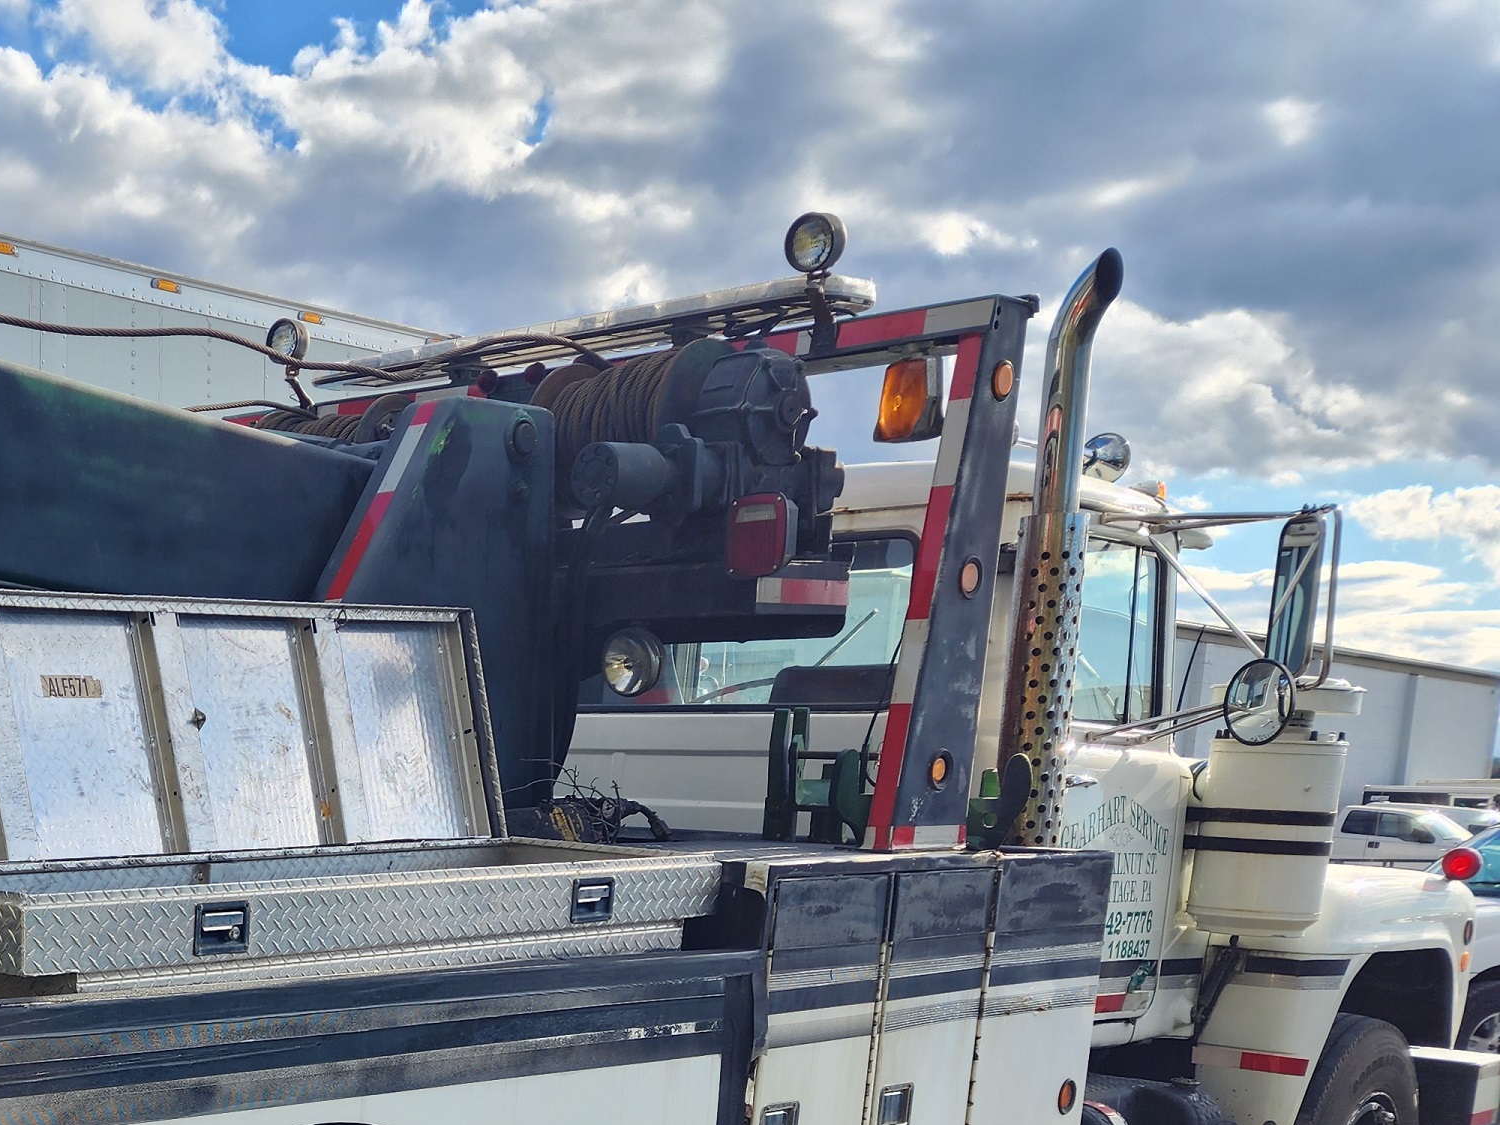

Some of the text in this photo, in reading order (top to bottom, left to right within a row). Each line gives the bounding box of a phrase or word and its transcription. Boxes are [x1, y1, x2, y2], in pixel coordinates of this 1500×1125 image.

[48, 677, 90, 697] ALF571
[1060, 796, 1169, 855] GEARHART SERVICE
[1145, 852, 1157, 874] ST.
[1108, 880, 1151, 906] TAGE, PA
[1108, 940, 1151, 959] 1188437
